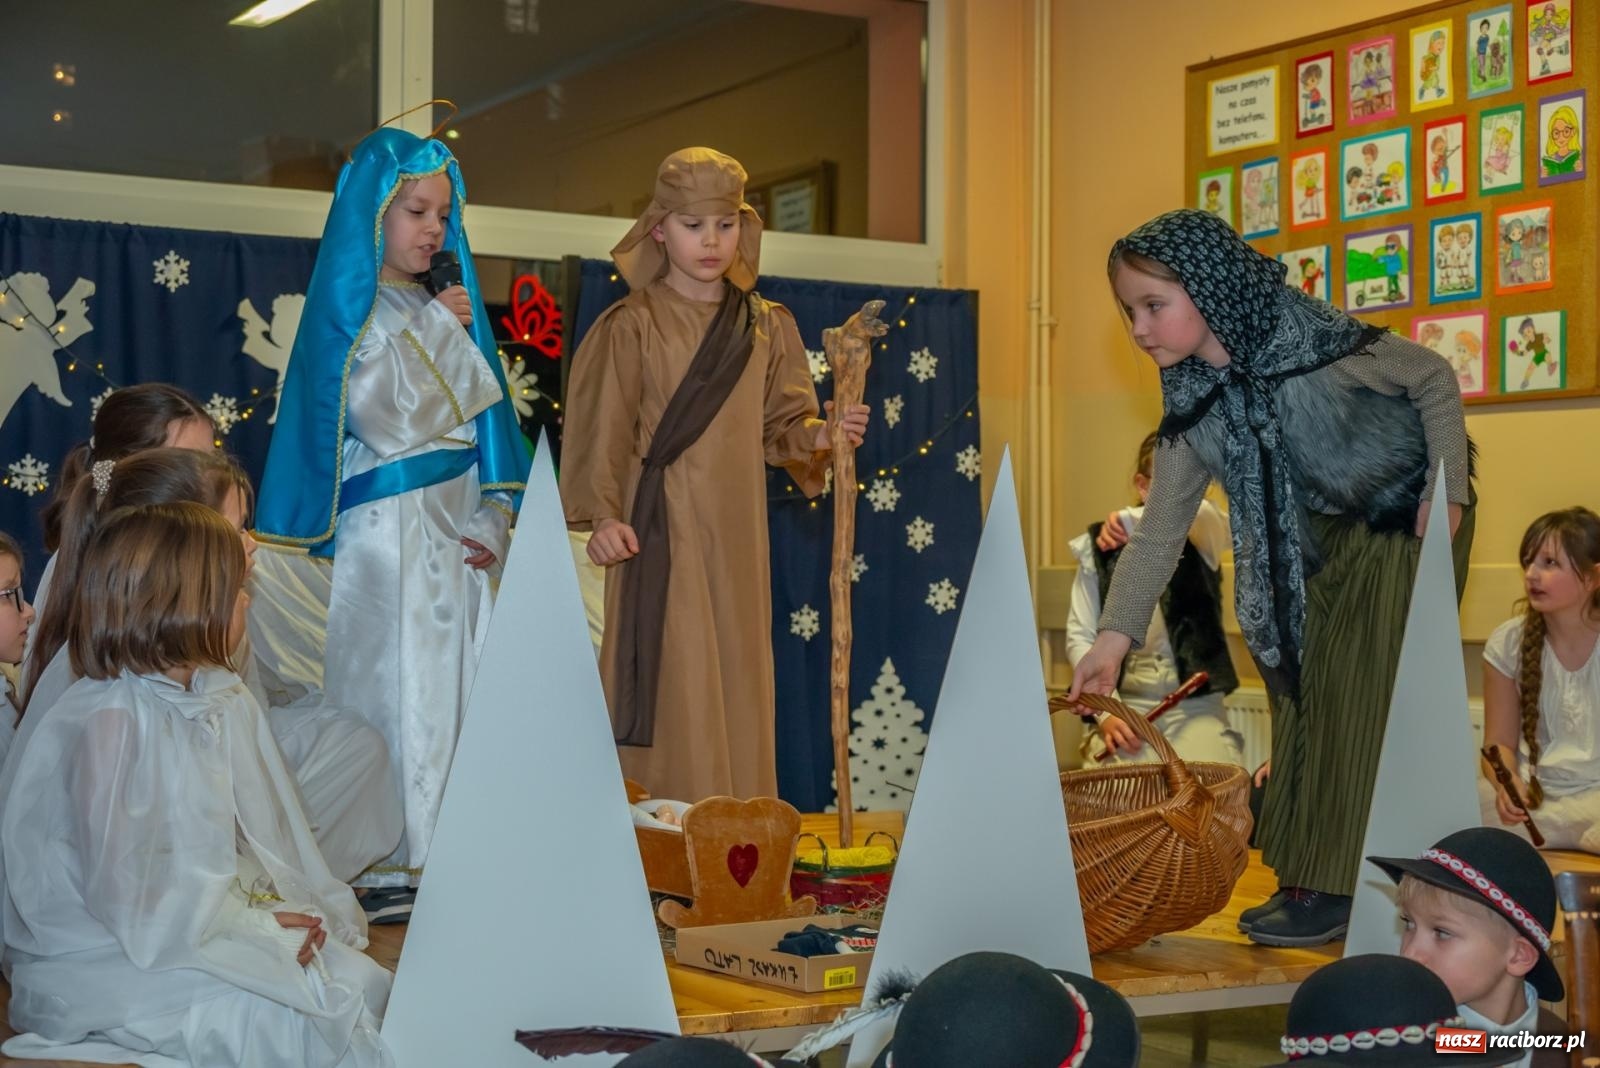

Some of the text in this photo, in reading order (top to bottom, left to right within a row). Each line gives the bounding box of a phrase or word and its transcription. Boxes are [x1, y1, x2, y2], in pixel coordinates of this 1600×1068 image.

[1215, 84, 1238, 95] Nasze
[1228, 97, 1257, 109] na czas
[1216, 119, 1231, 128] bez
[705, 948, 798, 984] ŁUKASZ LATO
